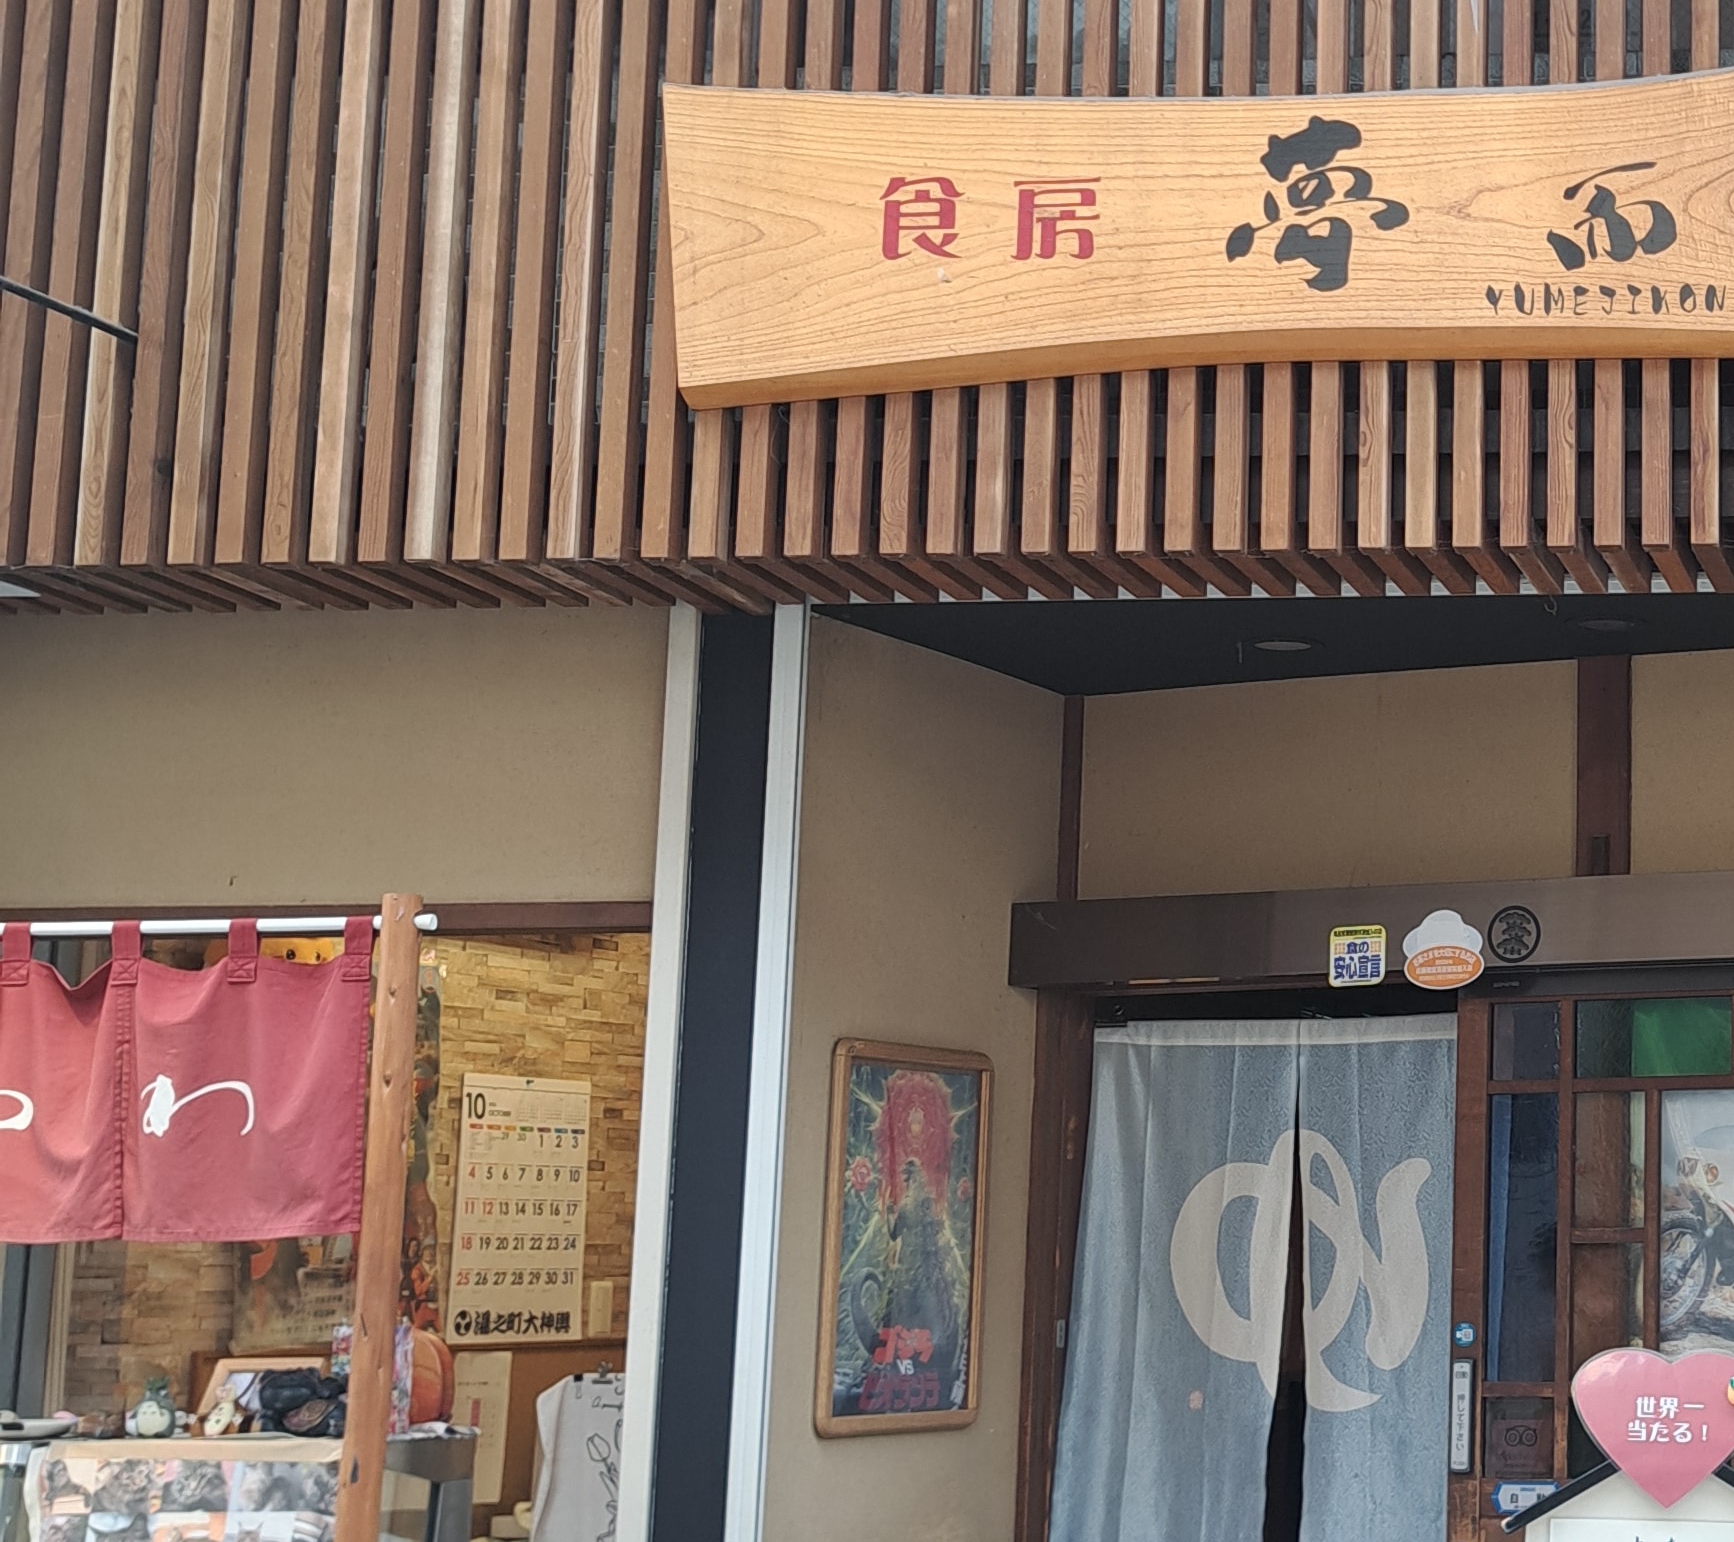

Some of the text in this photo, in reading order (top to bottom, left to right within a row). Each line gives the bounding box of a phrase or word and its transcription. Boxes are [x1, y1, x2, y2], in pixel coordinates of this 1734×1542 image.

[879, 176, 1102, 262] 食房
[1486, 284, 1728, 316] YUMEJIKON
[465, 1092, 486, 1119] 10
[896, 1359, 915, 1375] VS
[1636, 1396, 1705, 1419] 世界一
